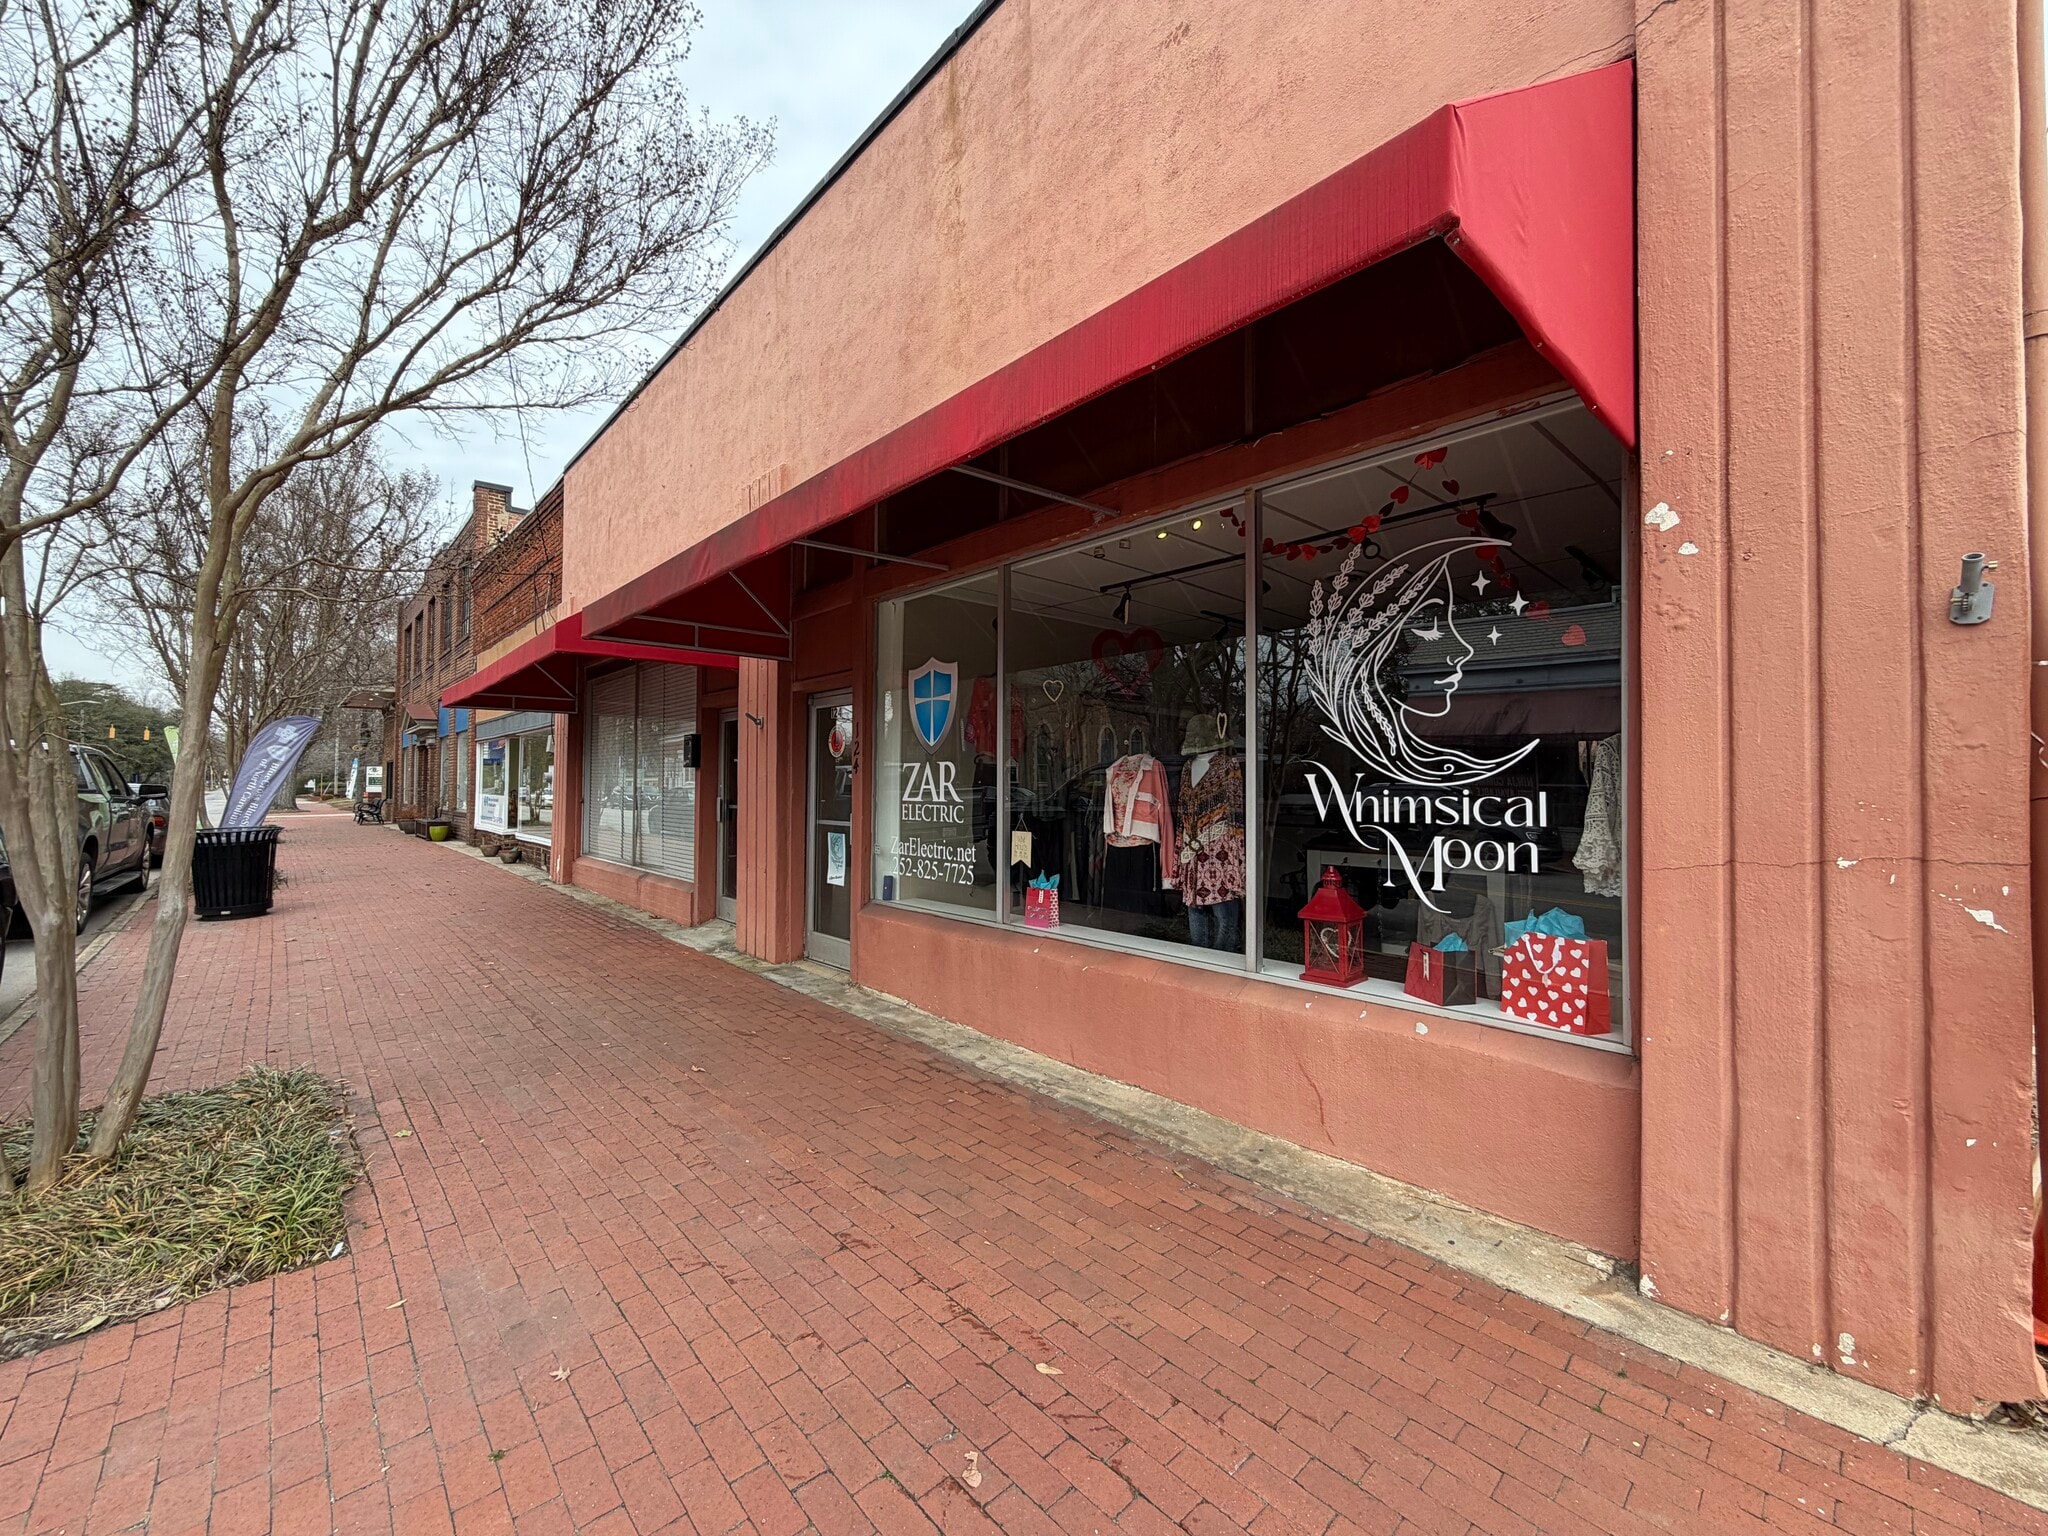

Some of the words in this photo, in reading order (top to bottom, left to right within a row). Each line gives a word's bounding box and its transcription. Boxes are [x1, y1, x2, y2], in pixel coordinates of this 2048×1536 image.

[260, 758, 268, 769] of
[246, 770, 265, 790] North
[902, 761, 963, 803] ZAR
[228, 791, 252, 825] Carolina
[902, 804, 965, 824] ELECTRIC
[1301, 760, 1548, 850] Whimsical
[890, 835, 977, 863] ZarElectric.net
[892, 856, 975, 886] 252-825-7725
[1360, 825, 1539, 914] Moon
